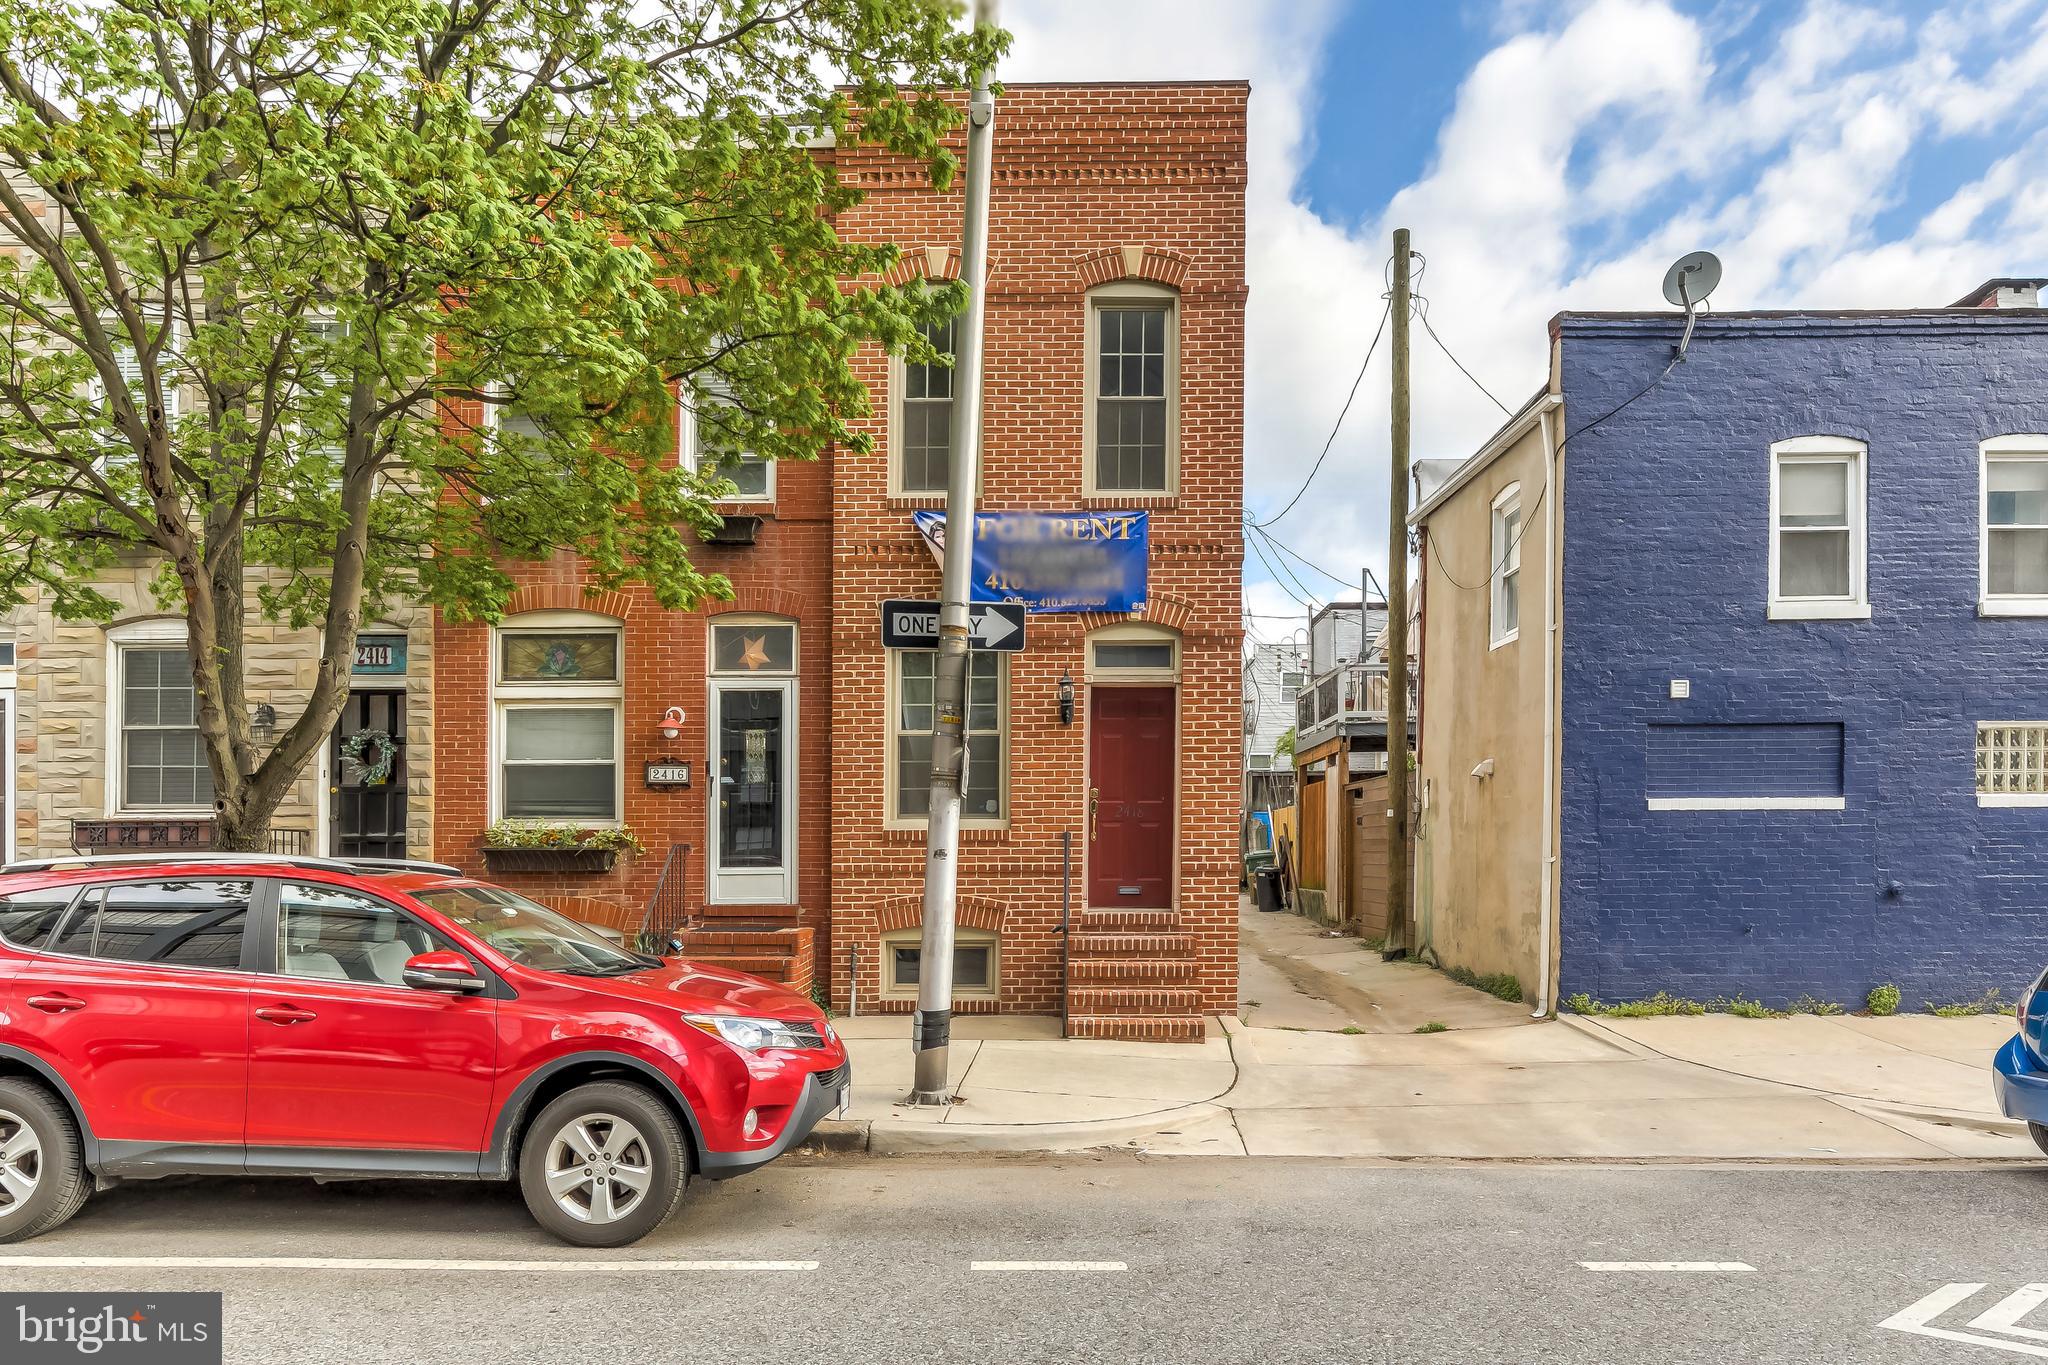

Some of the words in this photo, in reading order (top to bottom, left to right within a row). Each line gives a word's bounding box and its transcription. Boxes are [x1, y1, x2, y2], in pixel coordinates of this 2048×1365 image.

[1052, 516, 1136, 541] RENT
[898, 615, 937, 634] ONE
[357, 645, 388, 665] 2414
[652, 769, 684, 780] 2416
